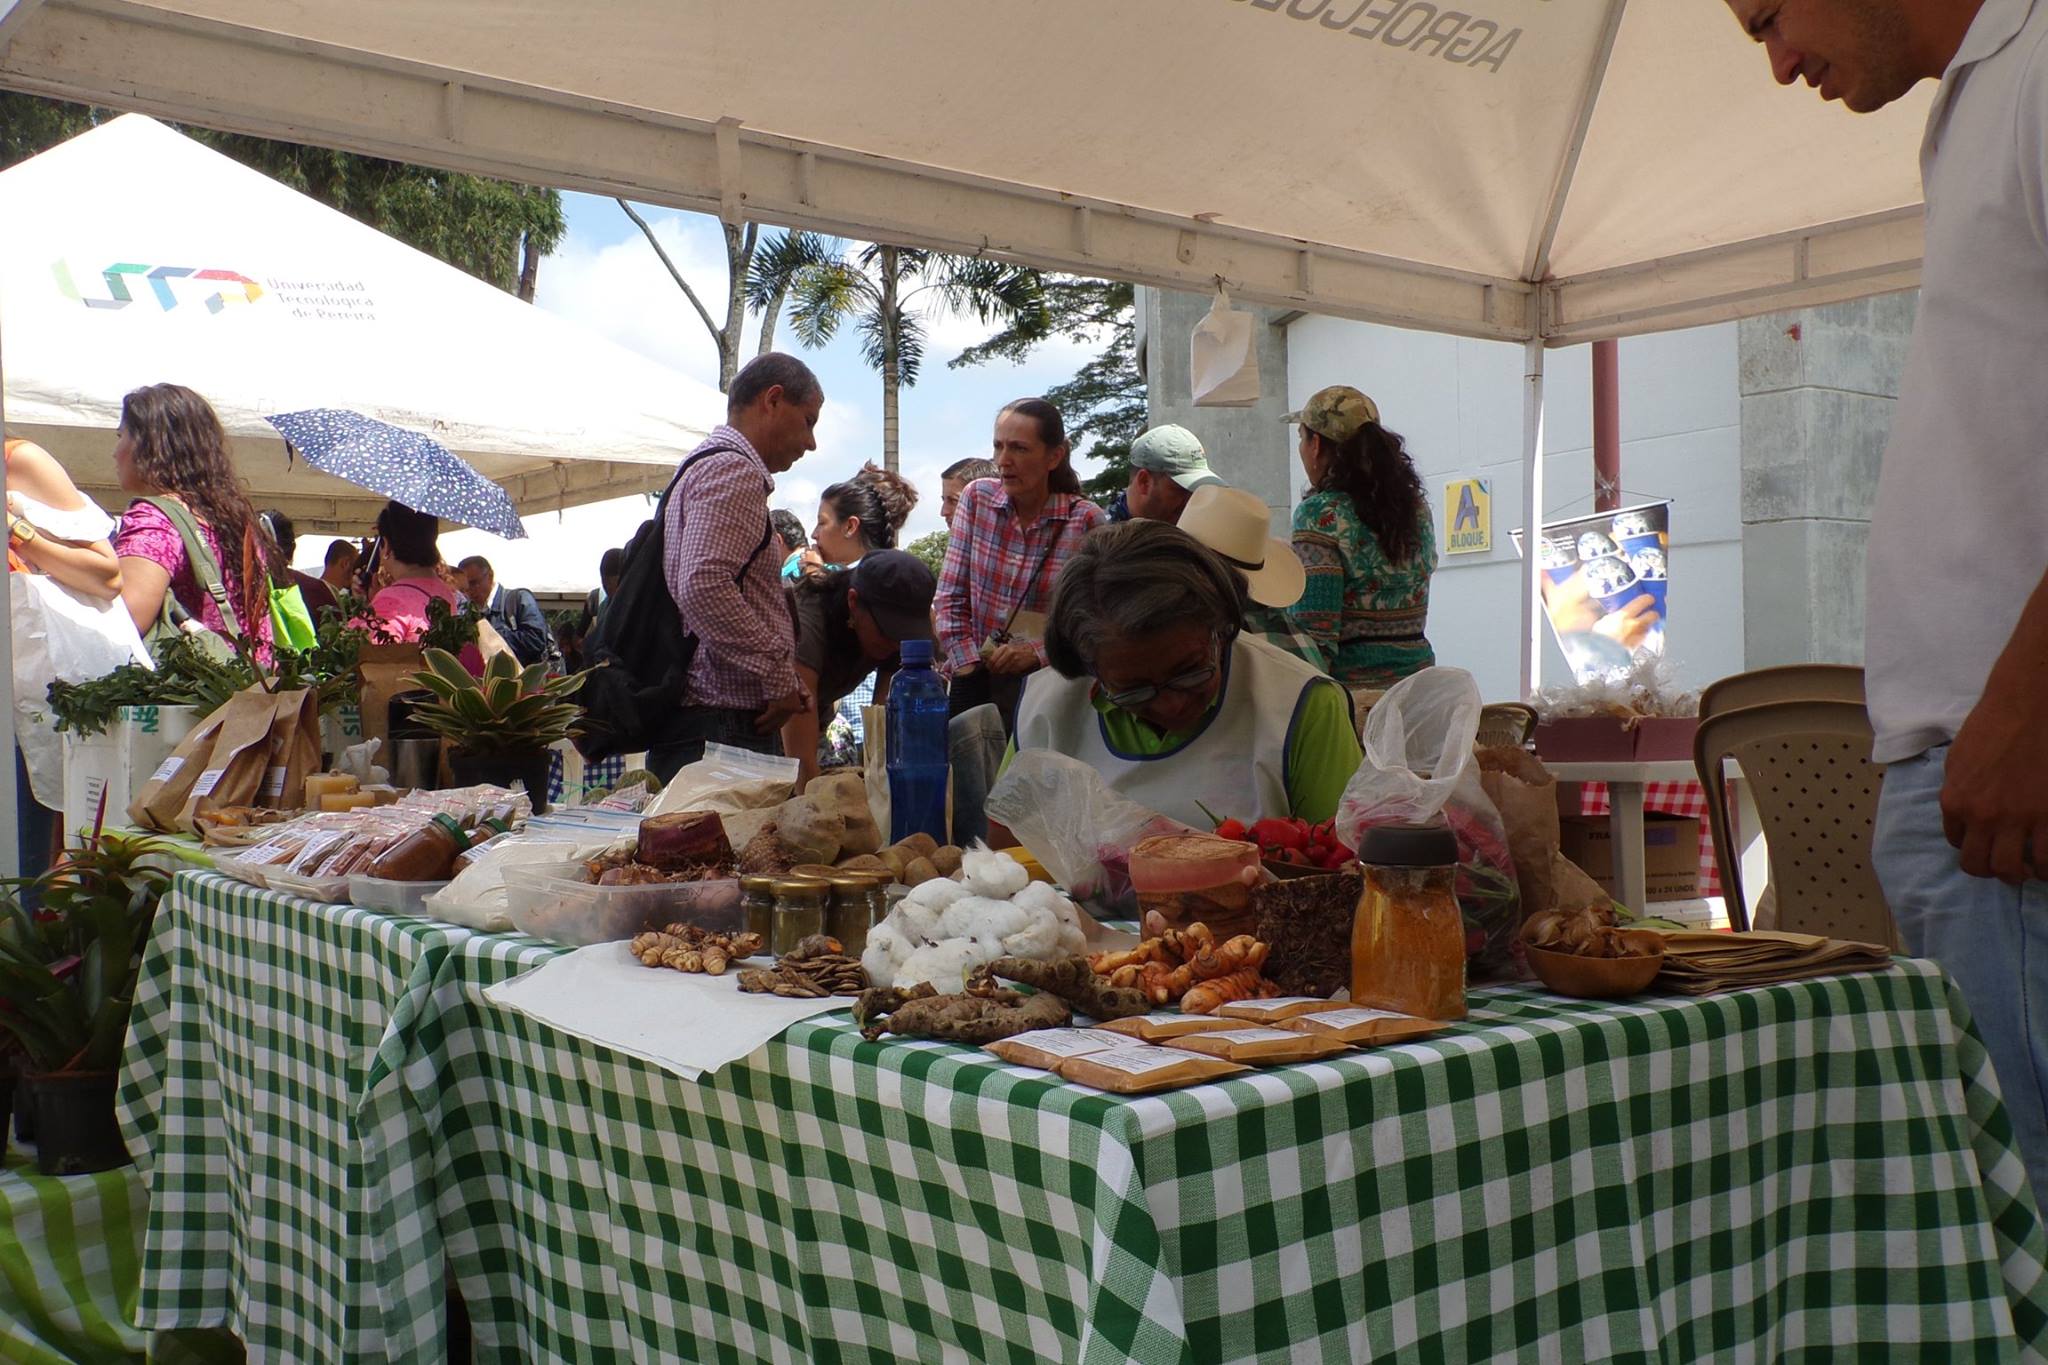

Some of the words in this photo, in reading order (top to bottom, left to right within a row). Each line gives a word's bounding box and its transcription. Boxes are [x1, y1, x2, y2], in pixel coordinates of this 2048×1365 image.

[267, 277, 366, 292] Universidad
[292, 307, 312, 319] de
[316, 308, 376, 321] Pereira
[1454, 485, 1480, 530] A
[1450, 531, 1484, 548] BLOQUE
